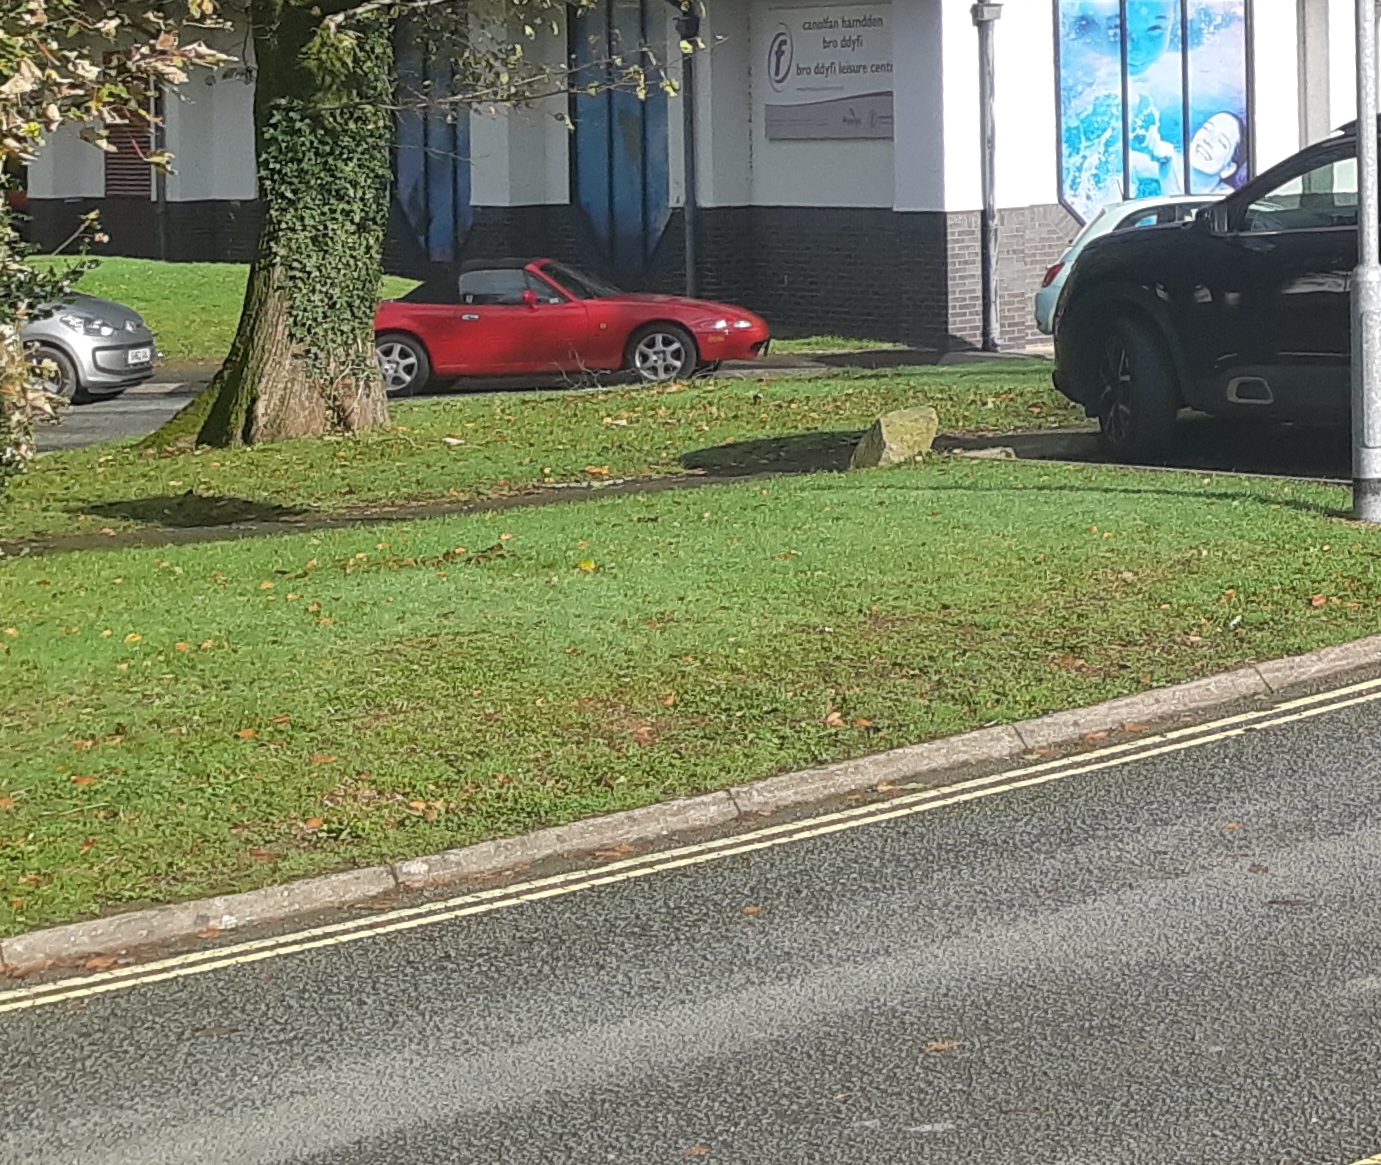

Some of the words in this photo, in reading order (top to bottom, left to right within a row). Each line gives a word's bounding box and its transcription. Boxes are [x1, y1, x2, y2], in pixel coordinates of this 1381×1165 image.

[803, 17, 838, 30] canolfan
[842, 15, 883, 28] hamdden
[823, 37, 838, 49] bro
[841, 35, 863, 52] ddyfi
[796, 63, 811, 76] bro
[814, 62, 836, 78] ddyfi
[839, 62, 868, 73] leisure
[871, 63, 893, 73] centr
